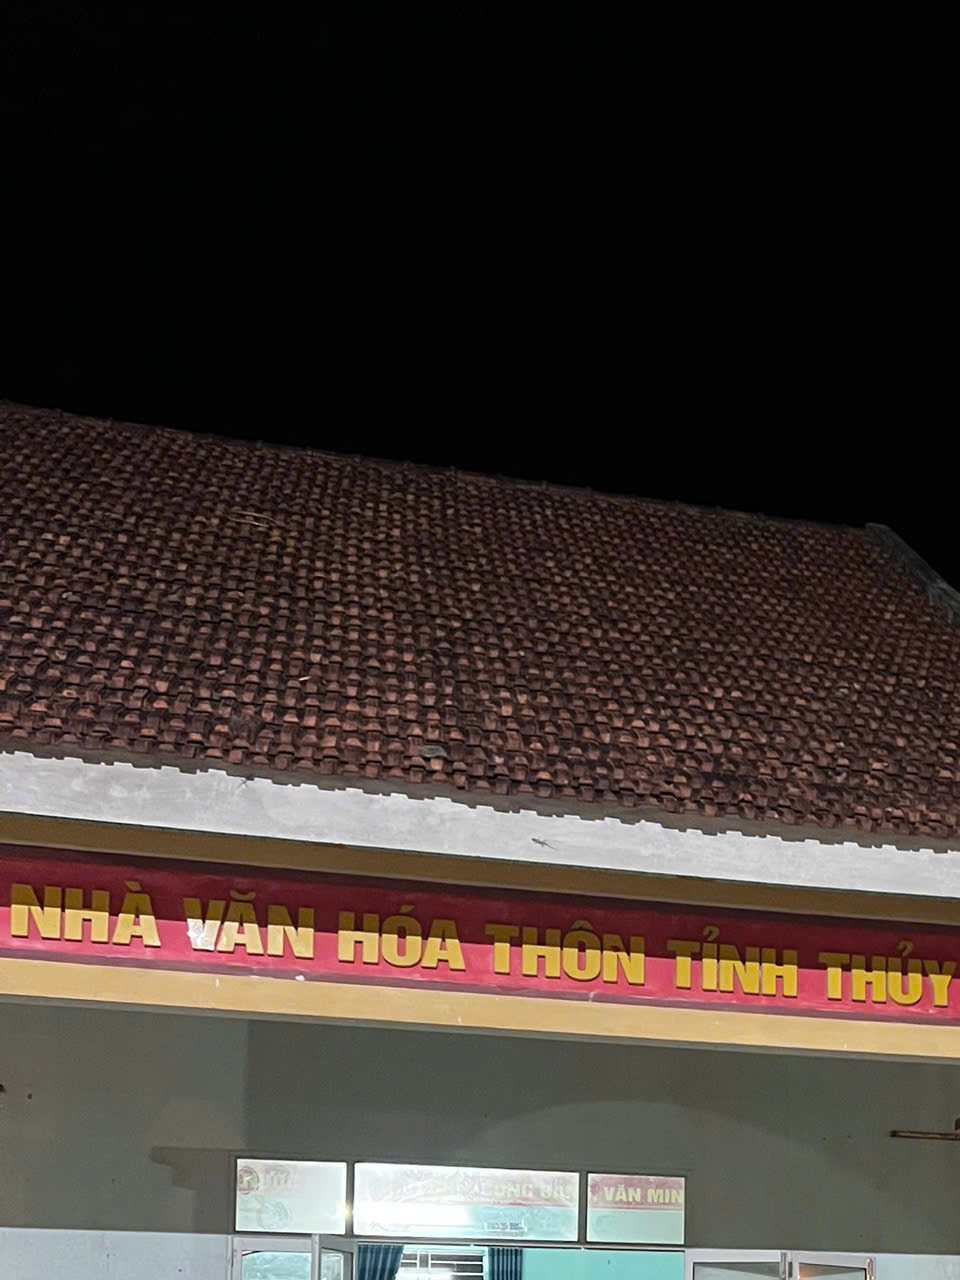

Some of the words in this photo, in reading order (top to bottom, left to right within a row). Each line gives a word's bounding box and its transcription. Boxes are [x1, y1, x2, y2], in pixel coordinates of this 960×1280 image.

[10, 881, 161, 948] NHÀ
[184, 890, 315, 960] VĂN
[337, 905, 466, 971] HÓA
[485, 920, 645, 985] THÔN
[667, 925, 798, 998] TỈNH
[818, 940, 958, 1008] THỦY
[603, 1183, 642, 1202] VĂN
